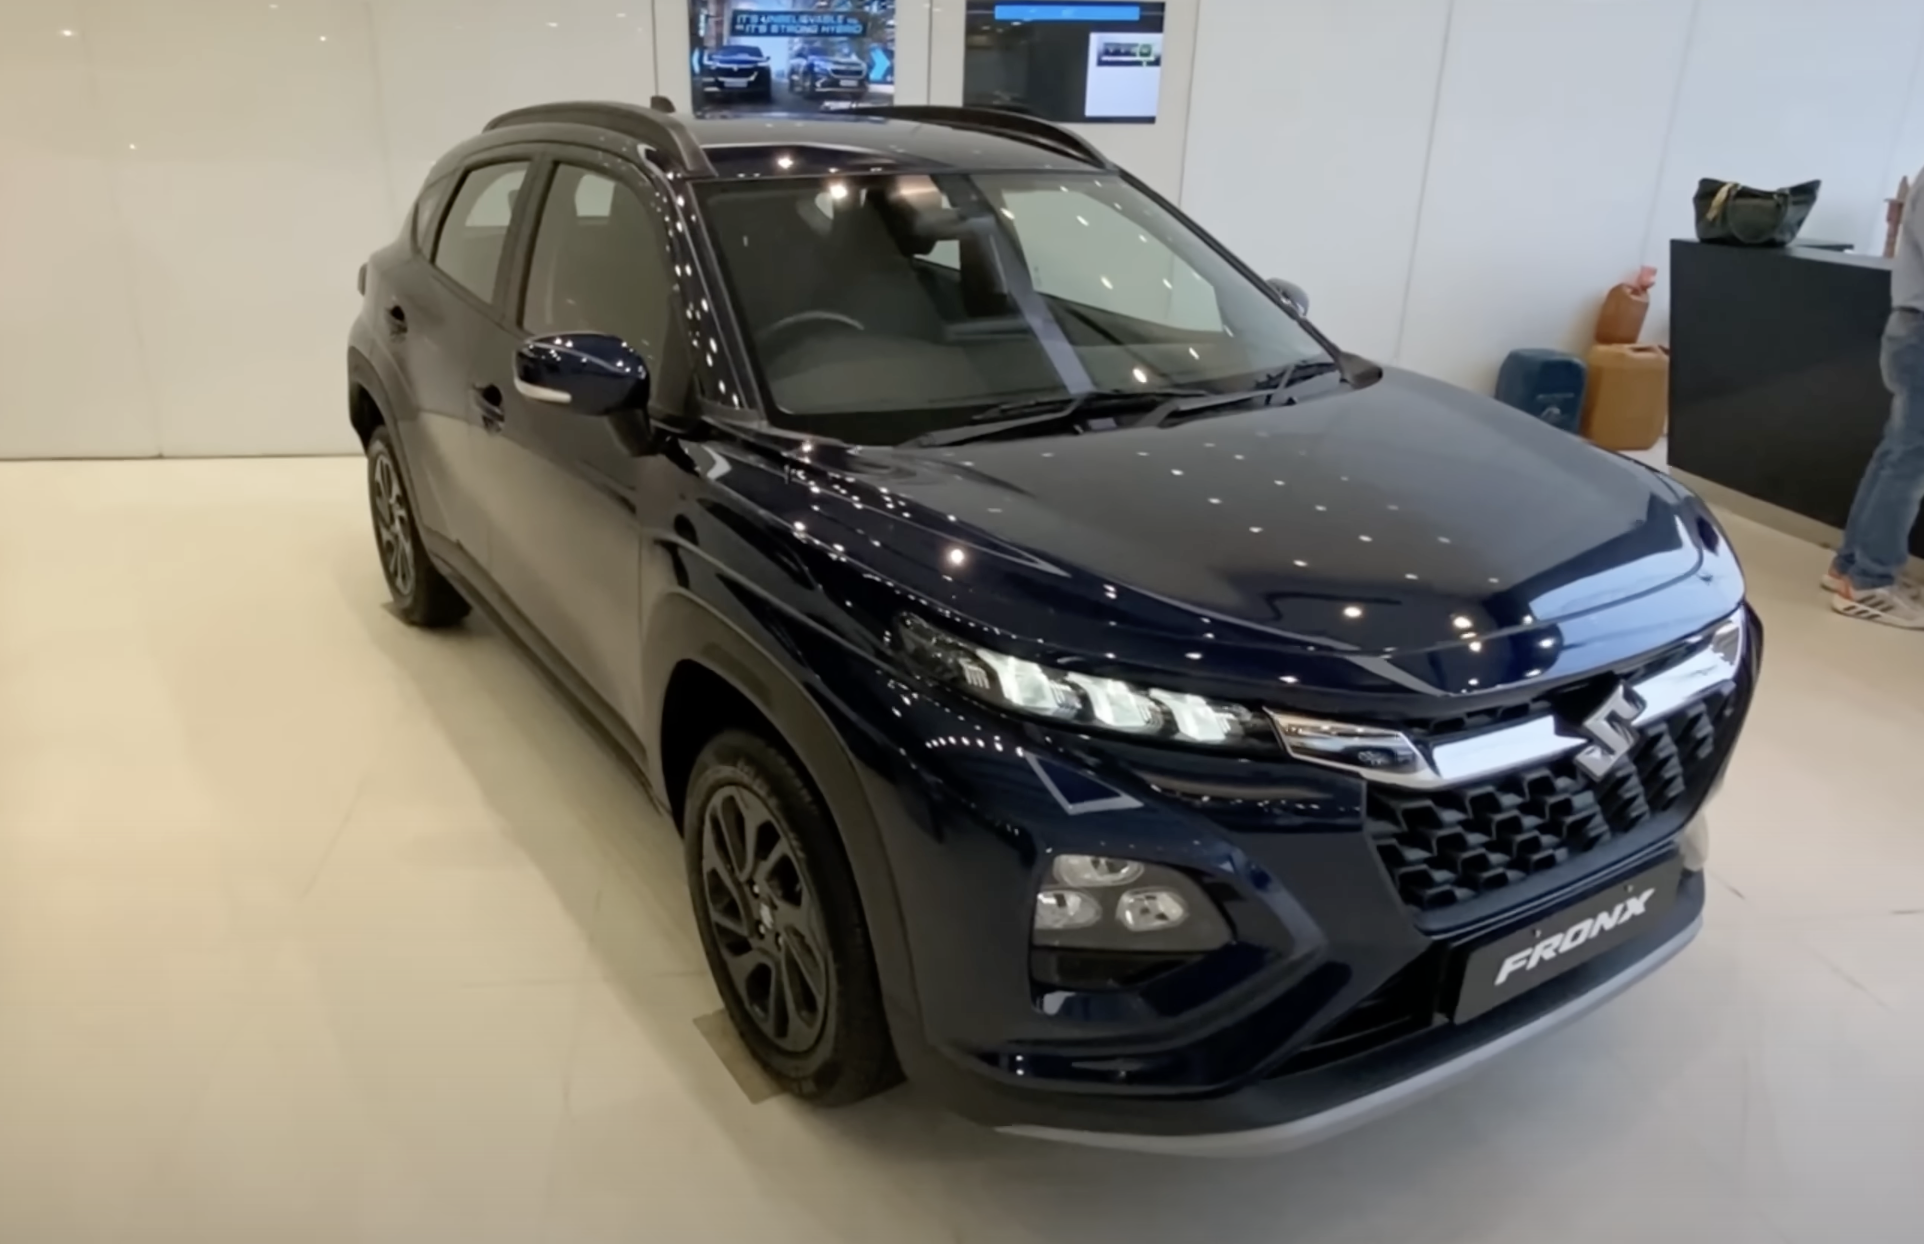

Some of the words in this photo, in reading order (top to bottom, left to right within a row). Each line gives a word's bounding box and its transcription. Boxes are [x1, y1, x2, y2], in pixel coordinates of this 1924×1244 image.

[736, 14, 758, 24] IT'S
[745, 24, 767, 34] IT'S
[771, 24, 818, 34] STRONG
[1494, 888, 1656, 986] FRONX
